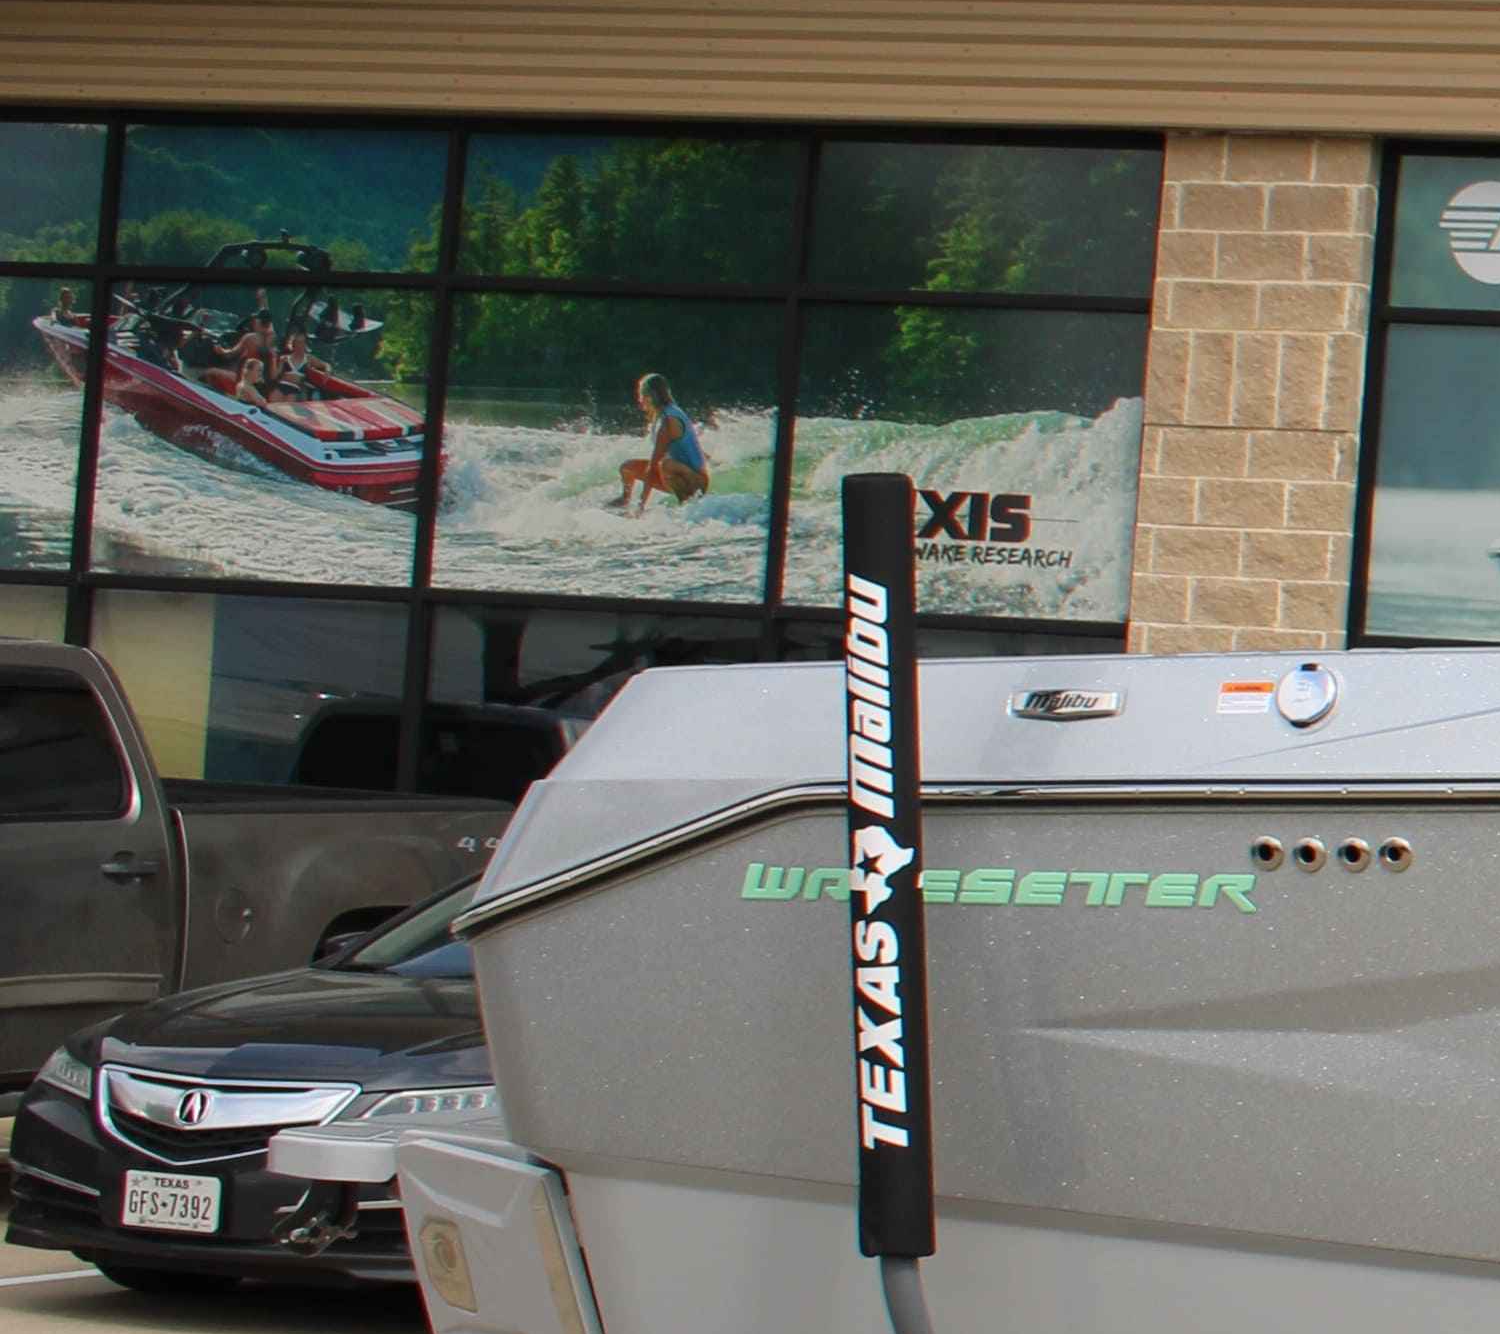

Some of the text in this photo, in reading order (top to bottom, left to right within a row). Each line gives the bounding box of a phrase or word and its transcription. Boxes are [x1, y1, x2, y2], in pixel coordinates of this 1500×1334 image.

[913, 488, 1033, 543] XIS
[970, 544, 1073, 569] RESEARCH
[1024, 691, 1099, 709] Malibu
[846, 572, 910, 1150] TEXAS Malibu
[741, 862, 1257, 914] WAESETTER
[153, 1176, 191, 1190] TEXAS
